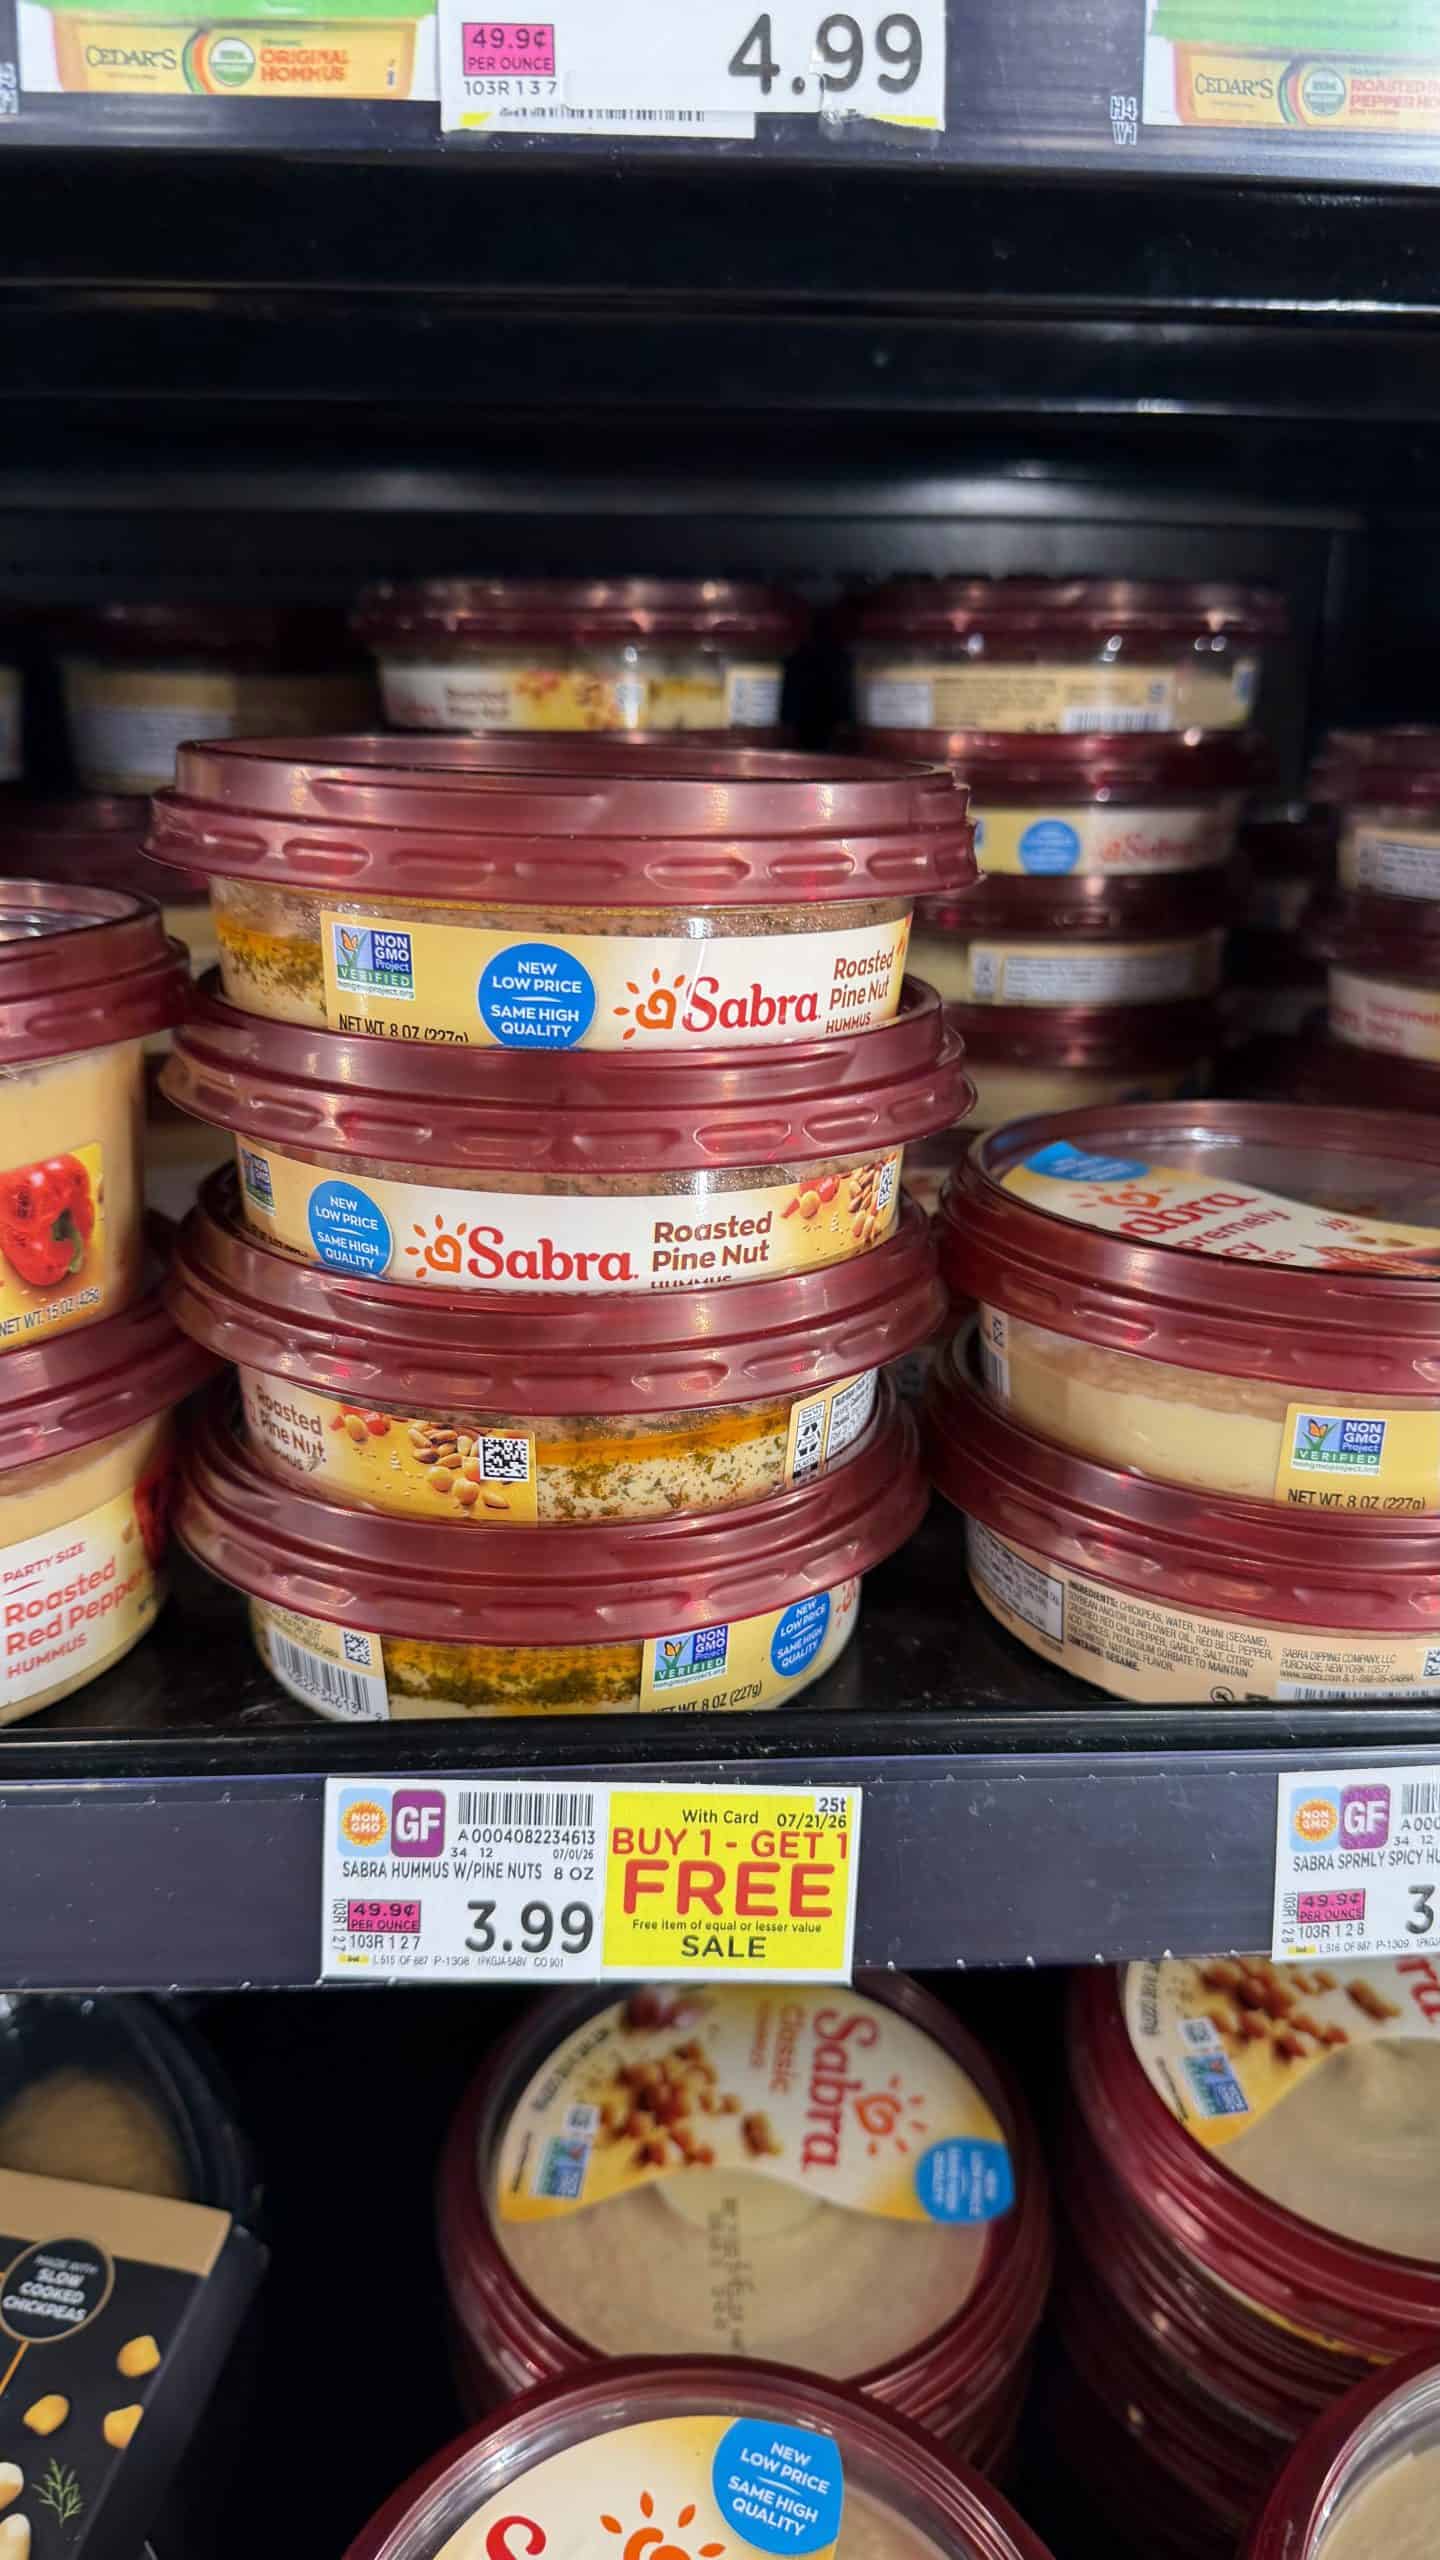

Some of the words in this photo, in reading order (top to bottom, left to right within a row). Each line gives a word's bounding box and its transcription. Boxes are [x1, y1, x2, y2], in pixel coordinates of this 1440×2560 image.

[472, 28, 547, 50] 49.9¢
[86, 45, 177, 71] CEDAR'S
[260, 48, 350, 65] ORIGINAL
[468, 56, 498, 71] PER
[501, 57, 553, 72] OUNCE
[728, 13, 923, 96] 4.99
[464, 80, 510, 96] 103R
[1195, 73, 1273, 99] CEDAR'S
[374, 933, 408, 949] NON
[375, 945, 410, 961] GMO
[833, 945, 894, 981] Roasted
[376, 959, 410, 973] Project
[518, 961, 557, 976] NEW
[340, 966, 411, 987] VERIFIED
[492, 976, 532, 991] LOW
[534, 978, 582, 994] PRICE
[829, 982, 865, 1010] Pine
[868, 976, 890, 1003] Nut
[491, 1004, 536, 1020] SAME
[539, 1008, 579, 1023] HIGH
[682, 976, 820, 1032] Sabra
[390, 1023, 398, 1039] 8
[402, 1024, 419, 1039] OZ
[501, 1022, 572, 1039] QUALITY
[825, 1011, 872, 1034] HUMMUS
[329, 1195, 358, 1211] NEW
[315, 1205, 343, 1223] LOW
[343, 1213, 379, 1231] PRICE
[653, 1210, 773, 1244] Roasted
[317, 1231, 347, 1249] SAME
[348, 1239, 380, 1255] HIGH
[325, 1248, 375, 1270] QUALITY
[467, 1225, 634, 1283] Sabra
[652, 1247, 716, 1274] Pine
[722, 1238, 770, 1266] Nut
[1344, 1432, 1380, 1444] GMO
[1346, 1422, 1382, 1434] NON
[1300, 1449, 1377, 1464] VERIFIED
[1343, 1442, 1379, 1454] Project
[1288, 1488, 1317, 1504] NET
[1347, 1495, 1356, 1508] 8
[1360, 1496, 1379, 1509] OZ
[3, 1555, 54, 1583] PARTY
[56, 1541, 87, 1564] SIZE
[4, 1554, 117, 1626] Roasted
[796, 1600, 817, 1617] NEW
[6, 1612, 63, 1655] Red
[696, 1627, 726, 1643] NON
[780, 1618, 802, 1637] LOW
[696, 1638, 726, 1653] GMO
[777, 1636, 802, 1657] SAME
[802, 1625, 823, 1645] HIGH
[7, 1632, 88, 1679] HUMMUS
[781, 1641, 818, 1668] QUALITY
[658, 1658, 724, 1680] VERIFIED
[712, 1693, 728, 1709] OZ
[818, 1797, 846, 1813] 25t
[1302, 1808, 1329, 1819] NON
[351, 1812, 380, 1823] NON
[395, 1806, 441, 1843] GF
[682, 1809, 718, 1824] With
[723, 1810, 759, 1825] Card
[776, 1813, 847, 1829] 07/21/26
[1302, 1818, 1329, 1829] GMO
[1344, 1800, 1387, 1835] GF
[351, 1822, 380, 1833] GMO
[612, 1827, 688, 1856] BUY
[751, 1830, 824, 1859] GET
[836, 1831, 847, 1859] 1
[1421, 1834, 1433, 1845] 12
[451, 1847, 467, 1858] 34
[480, 1847, 493, 1858] 12
[1293, 1855, 1334, 1872] SABRA
[1337, 1852, 1385, 1870] SPRMLY
[1388, 1850, 1423, 1866] SPICY
[343, 1863, 387, 1878] SABRA
[392, 1863, 449, 1879] HUMMUS
[454, 1863, 502, 1881] W/PINE
[508, 1863, 543, 1879] NUTS
[553, 1866, 564, 1881] 8
[569, 1867, 594, 1881] OZ
[622, 1859, 836, 1918] FREE
[353, 1902, 415, 1917] 49.9¢
[1300, 1912, 1321, 1921] PER
[1324, 1909, 1363, 1921] OUNCE
[351, 1919, 373, 1930] PER
[377, 1919, 418, 1931] OUNCE
[464, 1900, 594, 1954] 3.99
[632, 1919, 657, 1931] Free
[661, 1919, 687, 1931] item
[691, 1920, 703, 1931] of
[705, 1920, 737, 1934] equal
[740, 1922, 752, 1932] or
[755, 1921, 788, 1933] lesser
[791, 1921, 821, 1933] value
[1299, 1924, 1331, 1939] 103R
[350, 1934, 384, 1949] 103R
[681, 1935, 767, 1958] SALE
[801, 2008, 879, 2172] Sabra
[37, 2268, 85, 2288] SLOW
[19, 2281, 86, 2305] COOKED
[3, 2295, 88, 2322] CHICKPEAS
[769, 2441, 812, 2466] NEW
[741, 2448, 780, 2474] LOW
[779, 2465, 831, 2495] PRICE
[727, 2475, 774, 2505] SAME
[776, 2495, 819, 2524] HIGH
[732, 2498, 806, 2537] QUALITY
